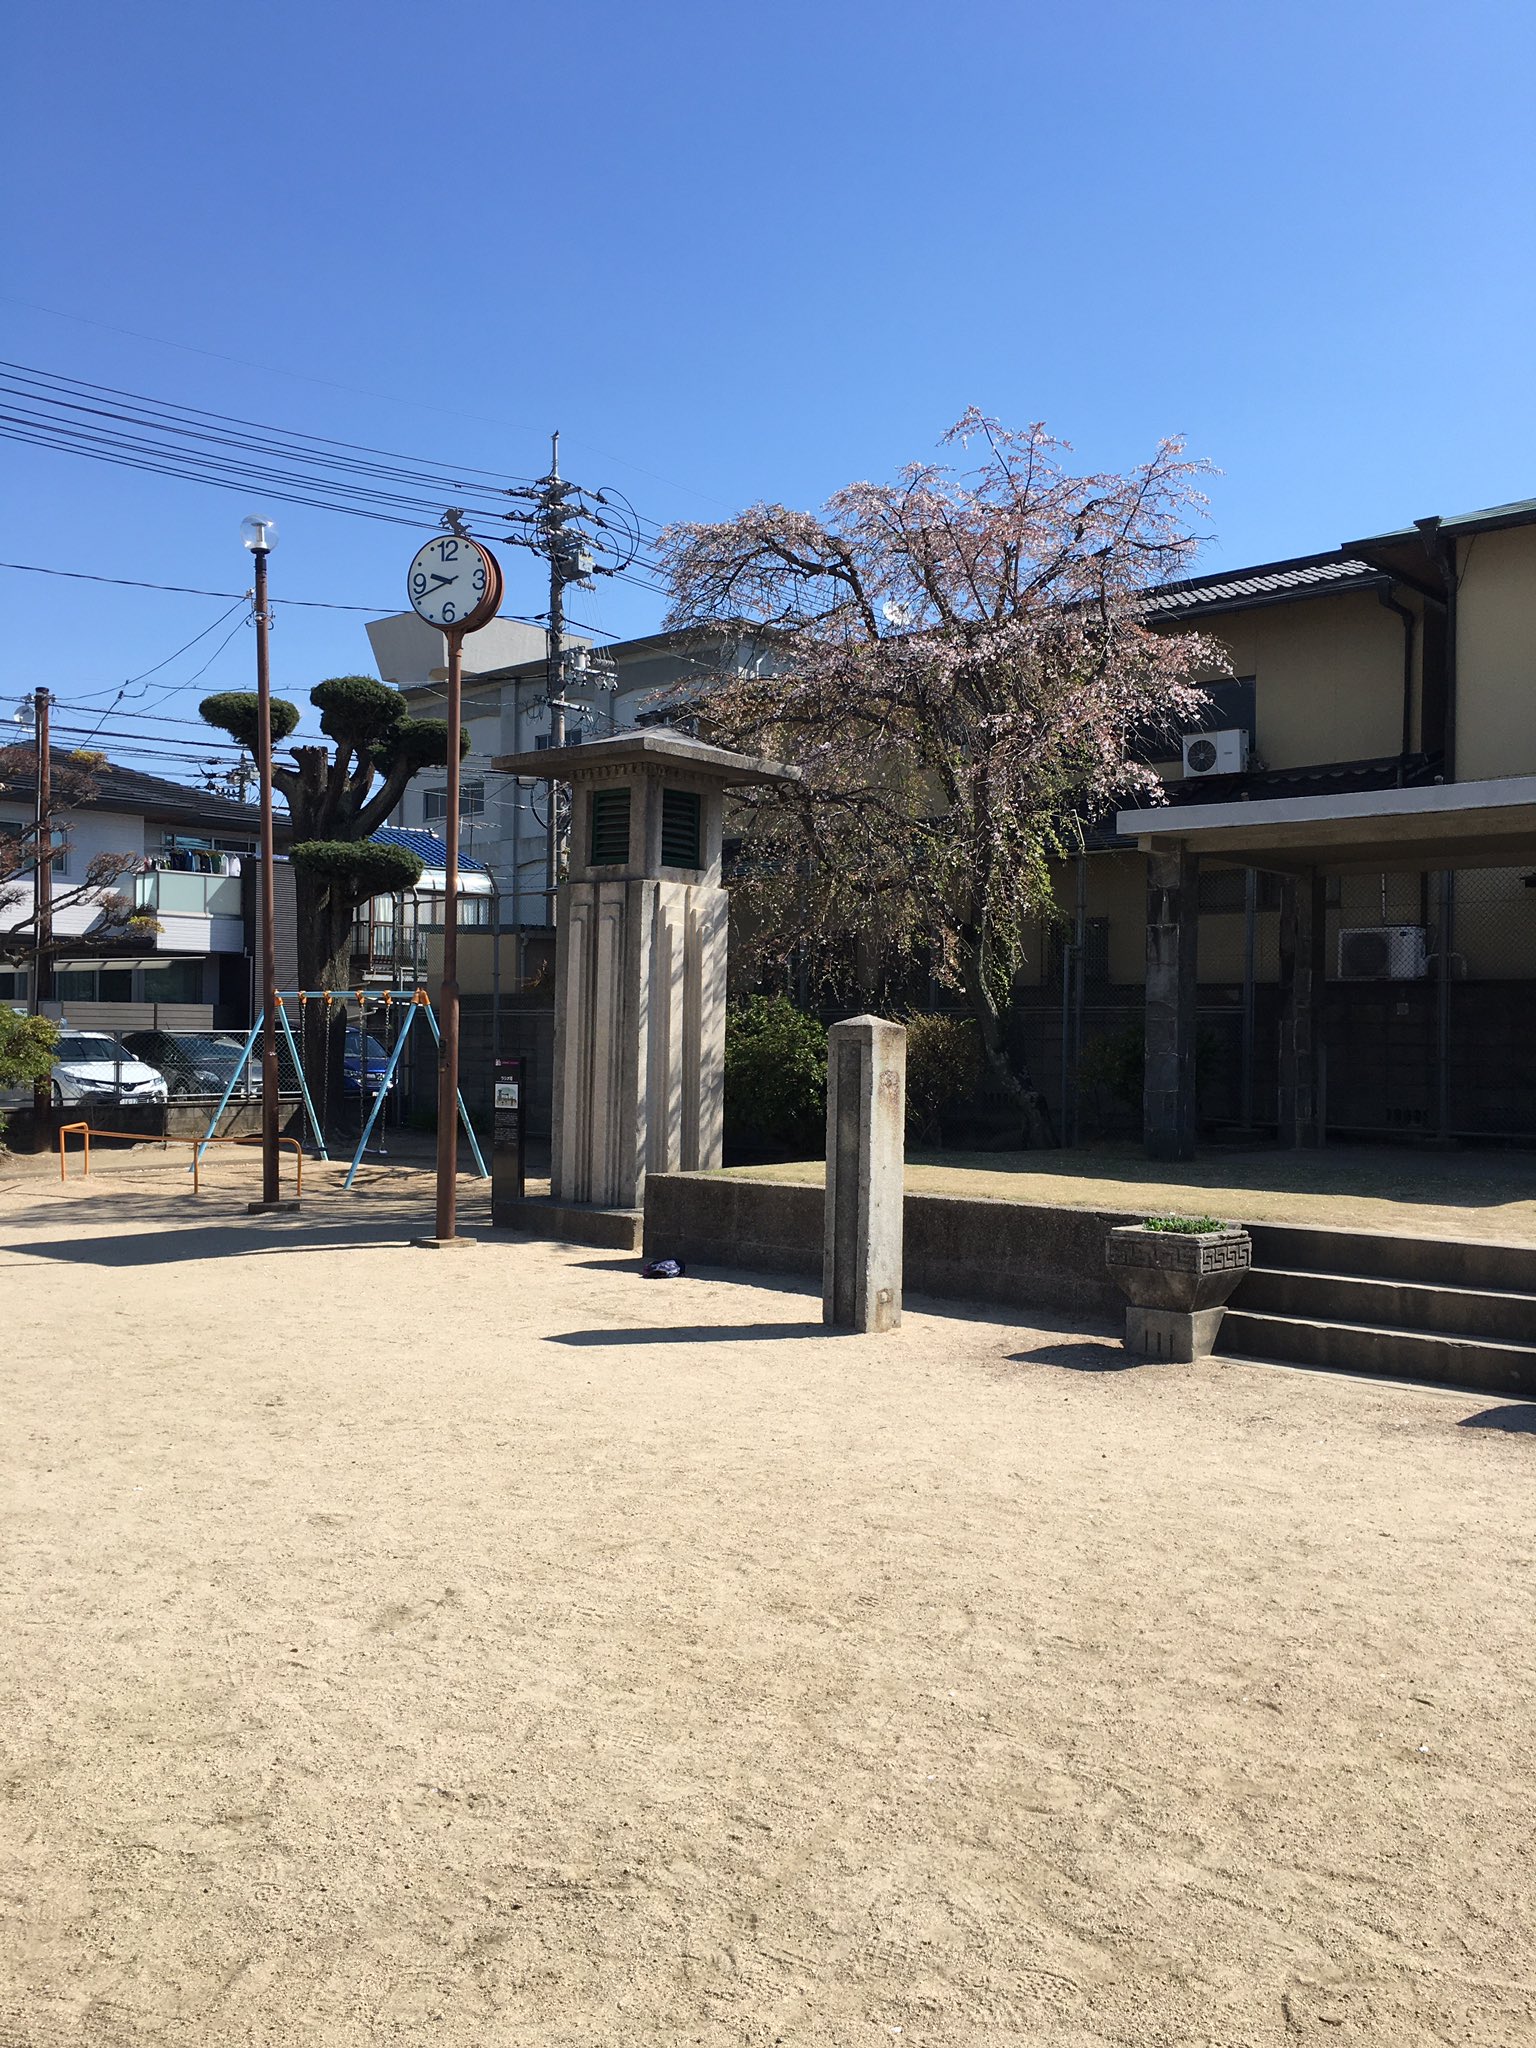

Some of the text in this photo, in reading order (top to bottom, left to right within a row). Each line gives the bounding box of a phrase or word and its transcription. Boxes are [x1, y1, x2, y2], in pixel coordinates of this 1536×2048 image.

[437, 540, 458, 562] 12
[413, 573, 426, 594] 9
[472, 569, 485, 590] 3
[442, 602, 455, 623] 6
